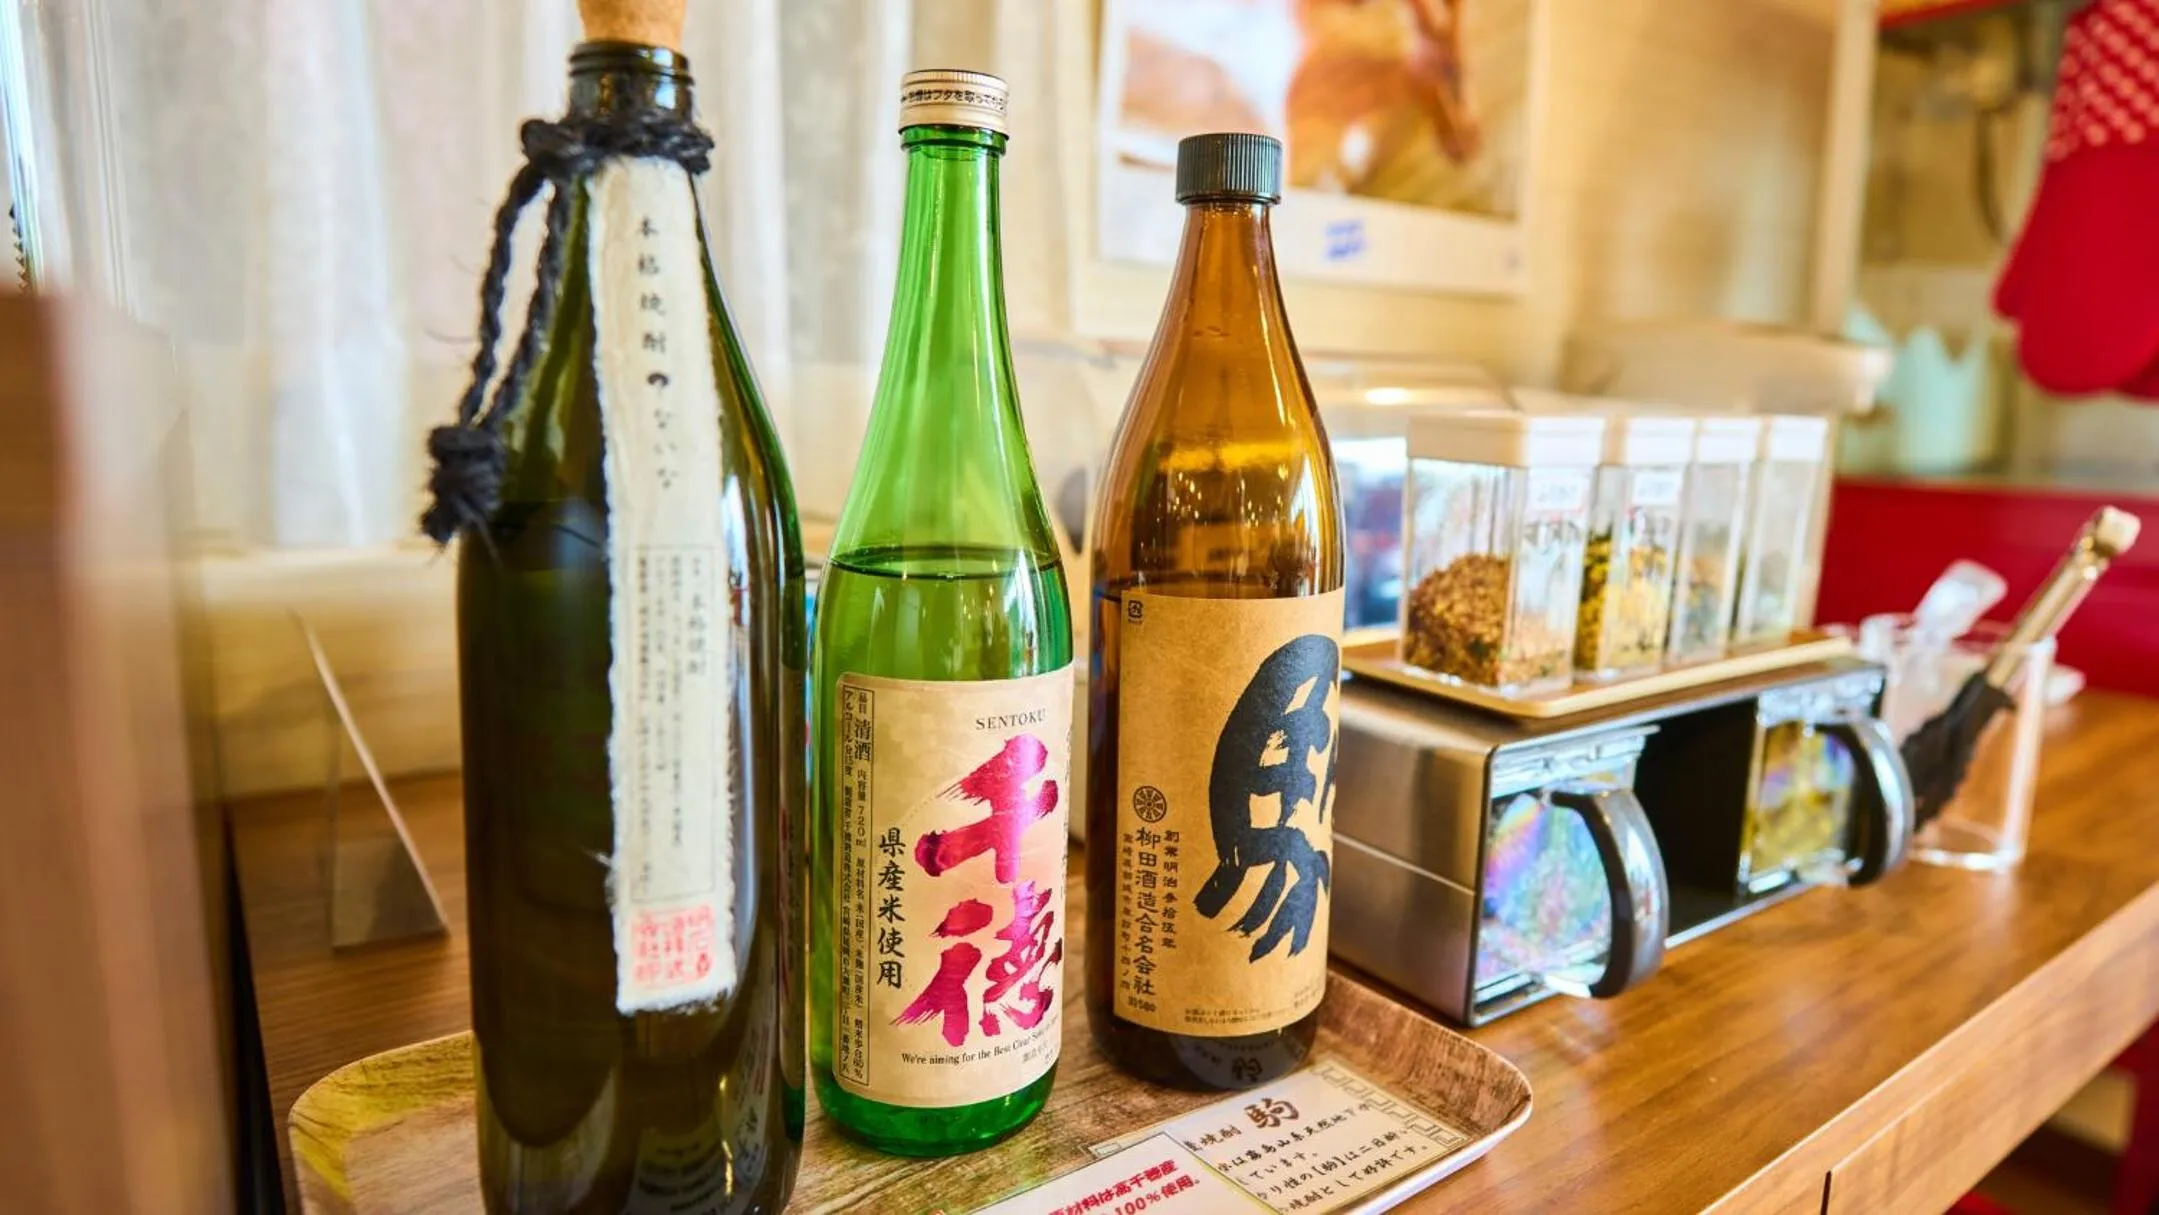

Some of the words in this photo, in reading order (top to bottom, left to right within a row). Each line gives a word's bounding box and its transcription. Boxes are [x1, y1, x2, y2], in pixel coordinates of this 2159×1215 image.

[975, 708, 1047, 731] SENTOKU
[854, 719, 872, 762] 清酒
[876, 827, 907, 990] 県産米使用
[1133, 825, 1161, 997] 柳田酒造合名会社
[901, 1051, 927, 1065] We're
[929, 1053, 960, 1066] aiming
[962, 1050, 976, 1063] for
[977, 1048, 991, 1061] the
[1244, 1097, 1300, 1130] 駒
